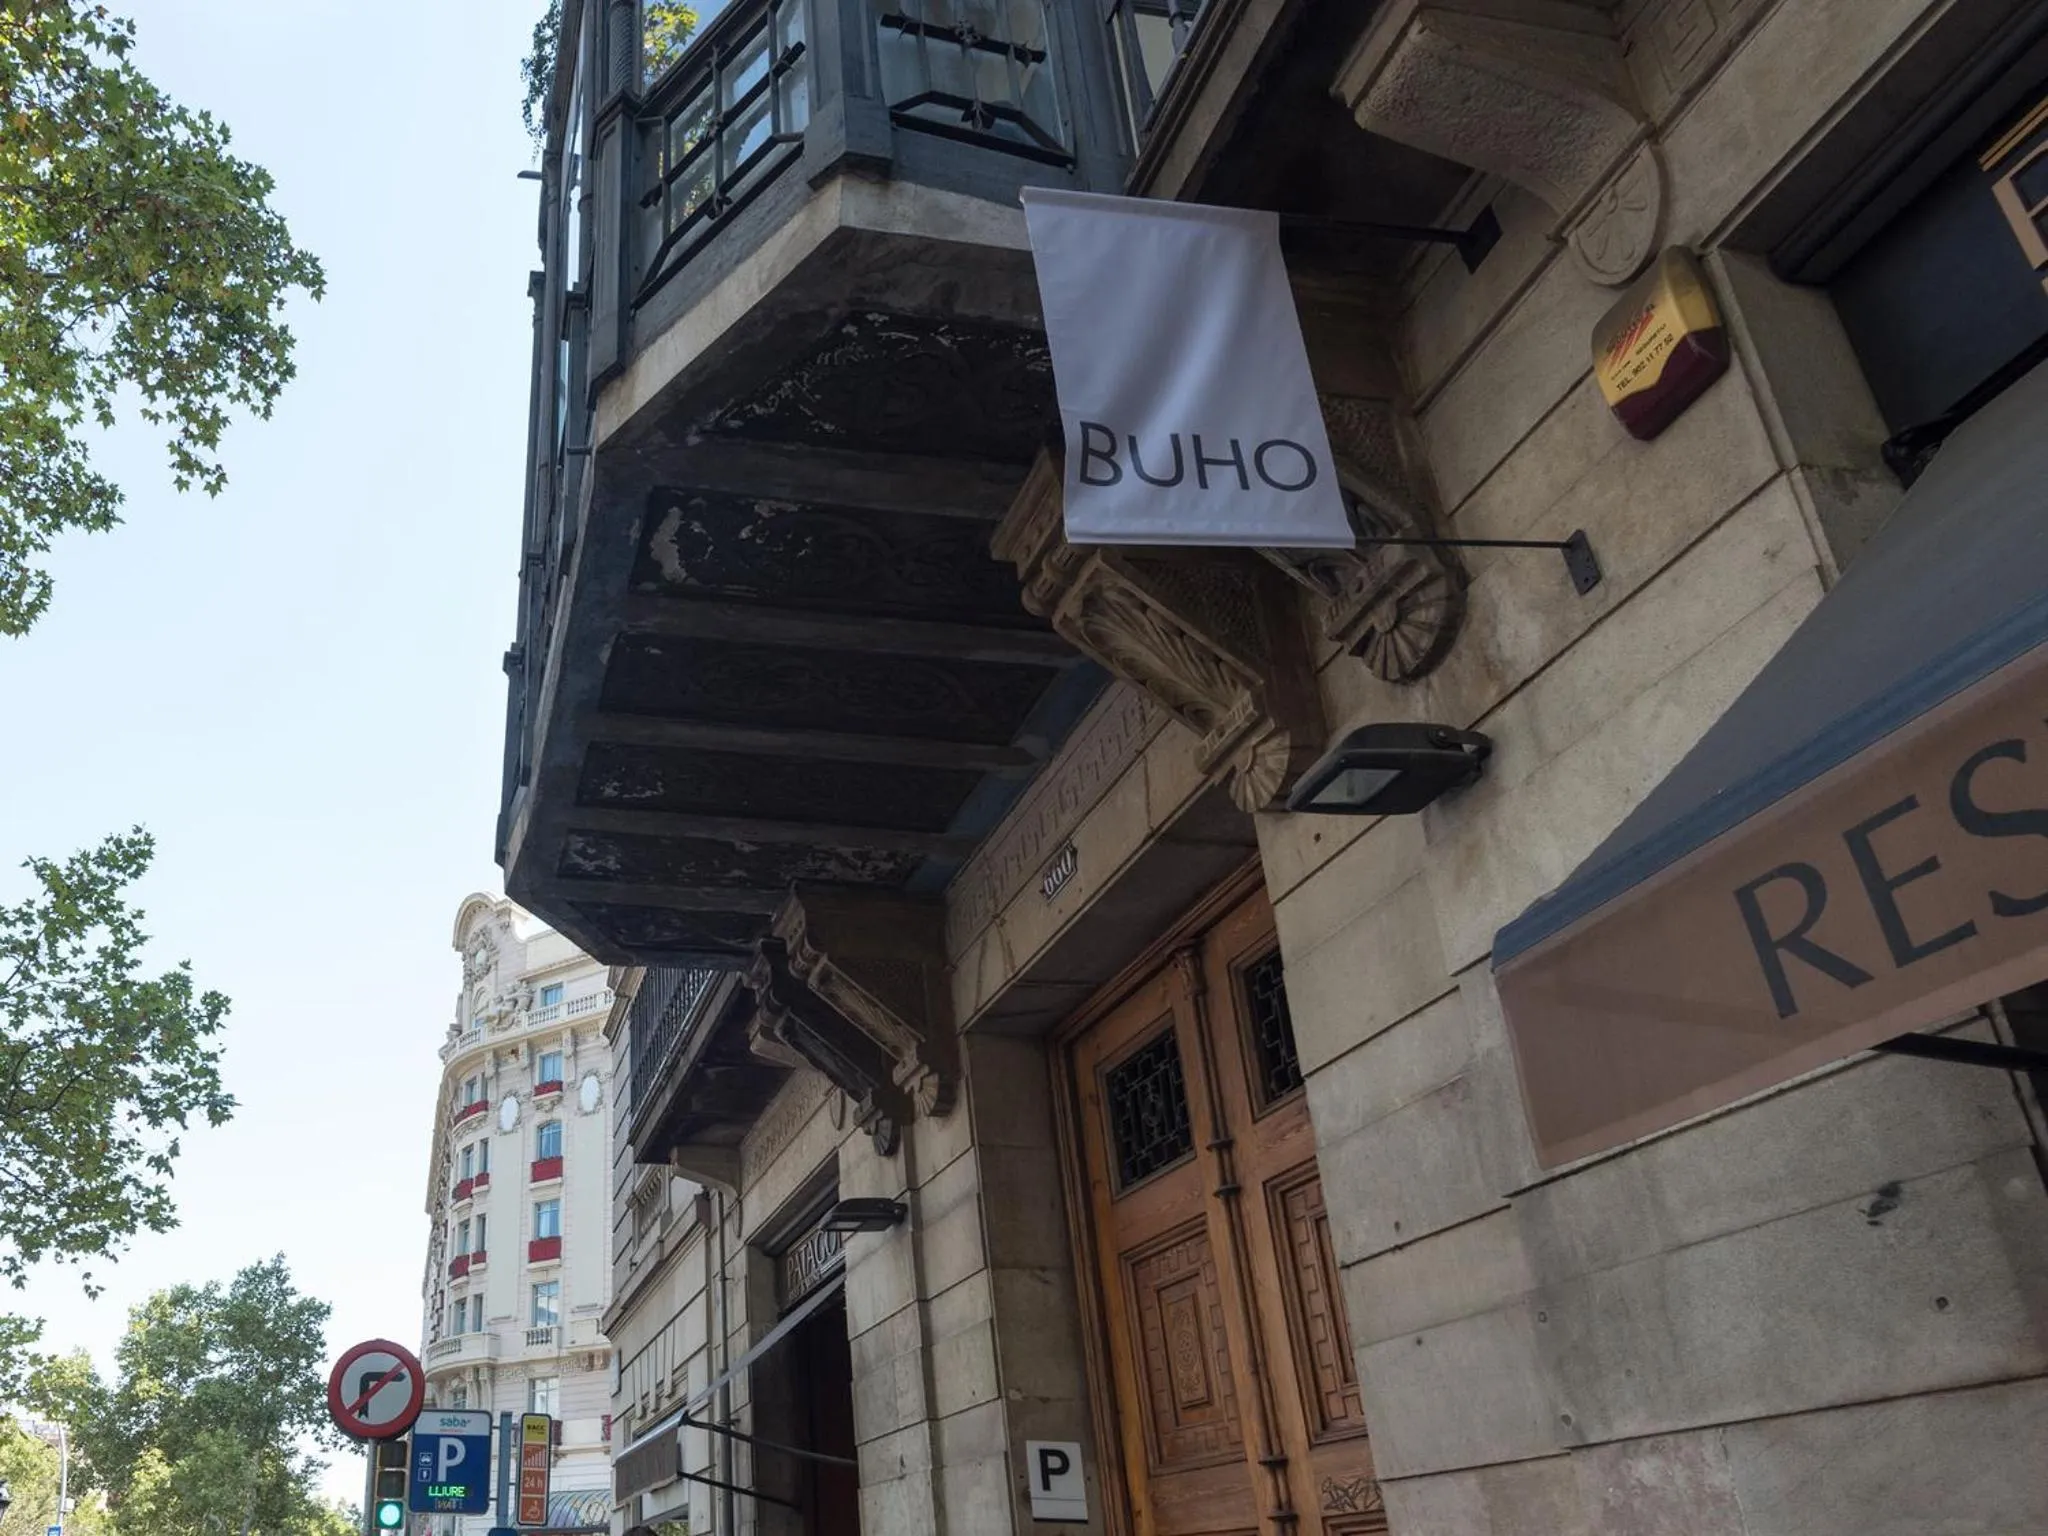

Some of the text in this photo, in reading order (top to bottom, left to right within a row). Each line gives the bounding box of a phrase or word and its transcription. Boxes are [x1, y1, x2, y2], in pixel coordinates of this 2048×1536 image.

[1079, 420, 1318, 492] BUHO
[1732, 718, 2048, 1020] RES
[439, 1414, 468, 1428] saba
[437, 1437, 466, 1482] P
[1039, 1448, 1070, 1491] P
[524, 1475, 535, 1489] 24
